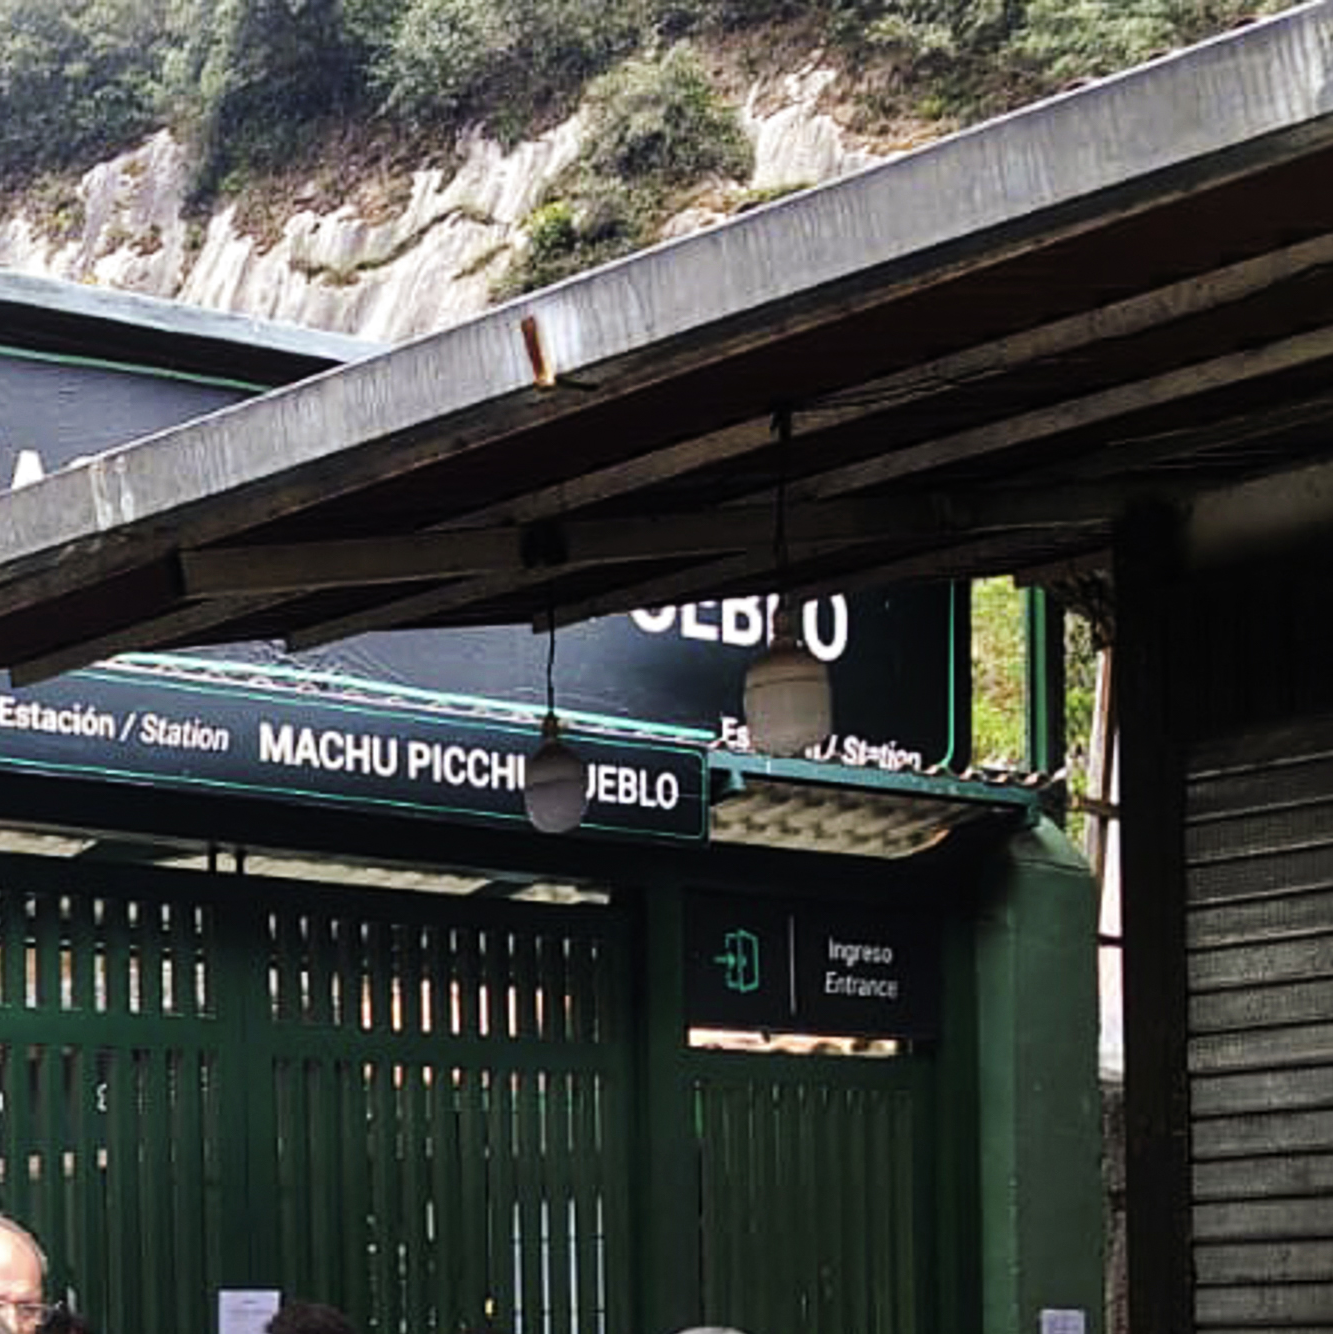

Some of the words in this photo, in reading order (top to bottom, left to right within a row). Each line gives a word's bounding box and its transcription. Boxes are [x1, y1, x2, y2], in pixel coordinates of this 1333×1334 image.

[119, 713, 136, 741] /
[139, 712, 230, 751] Station
[259, 722, 397, 777] MACHU
[828, 936, 893, 967] Ingreso
[825, 971, 898, 999] Entrance
